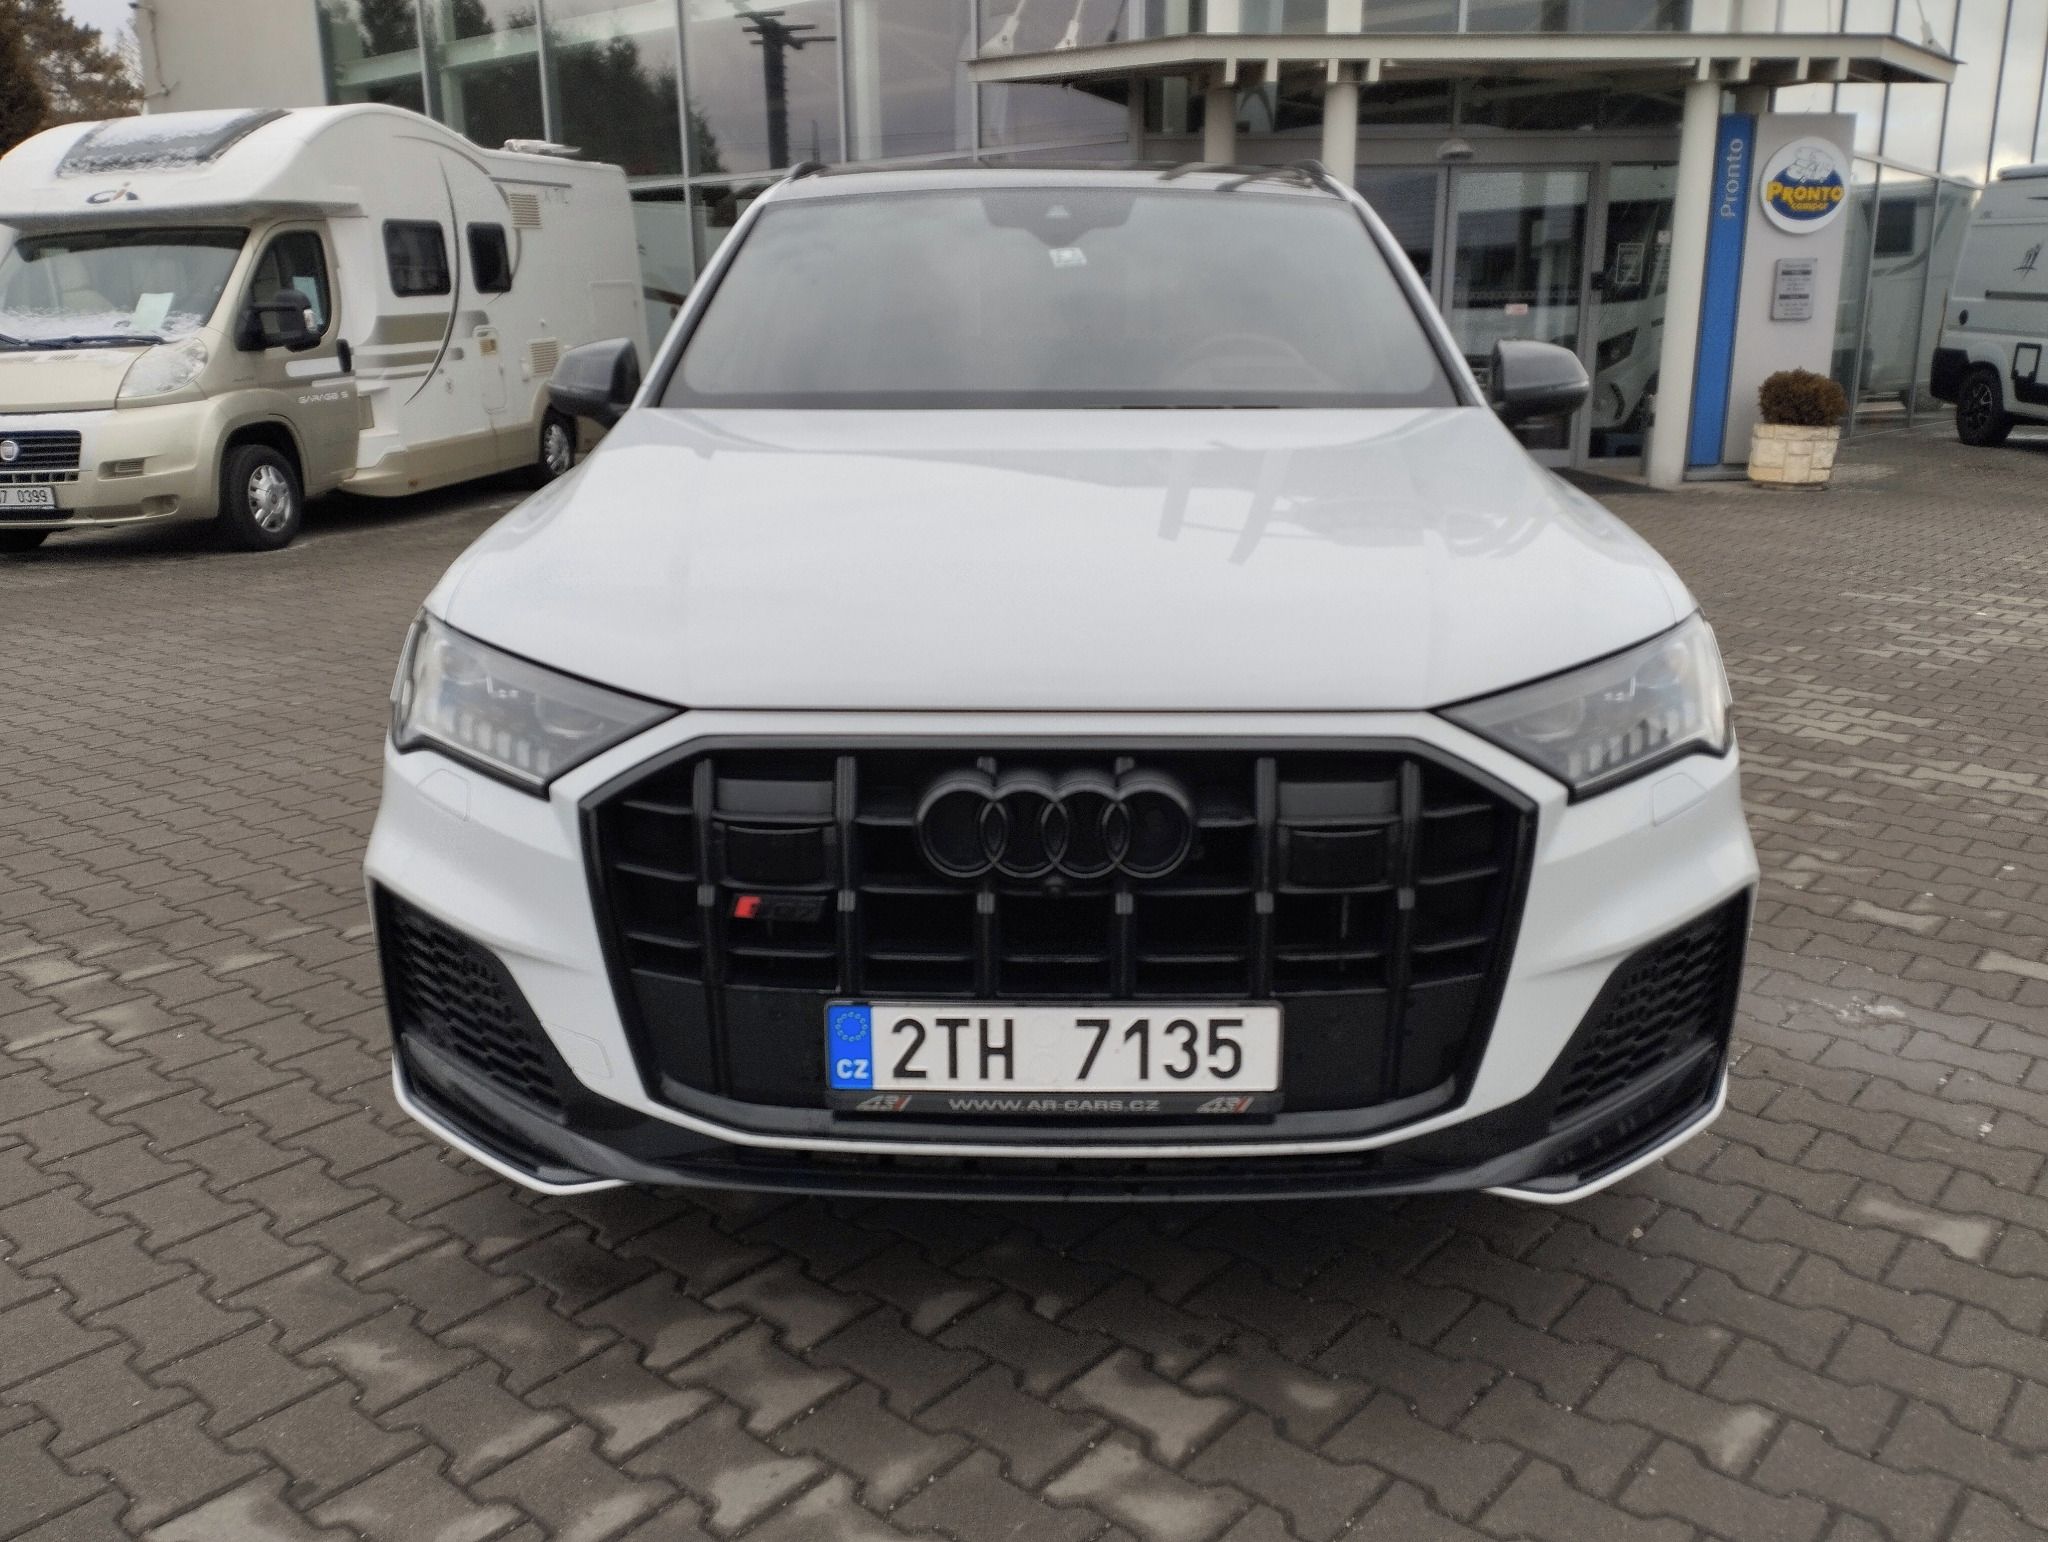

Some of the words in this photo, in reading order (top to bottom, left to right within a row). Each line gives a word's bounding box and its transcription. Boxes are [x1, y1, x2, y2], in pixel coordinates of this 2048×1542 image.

[1720, 138, 1744, 217] Pronto
[17, 489, 47, 503] 0399
[836, 1058, 869, 1079] CZ
[892, 1018, 1014, 1079] 2TH
[1075, 1018, 1243, 1079] 7135
